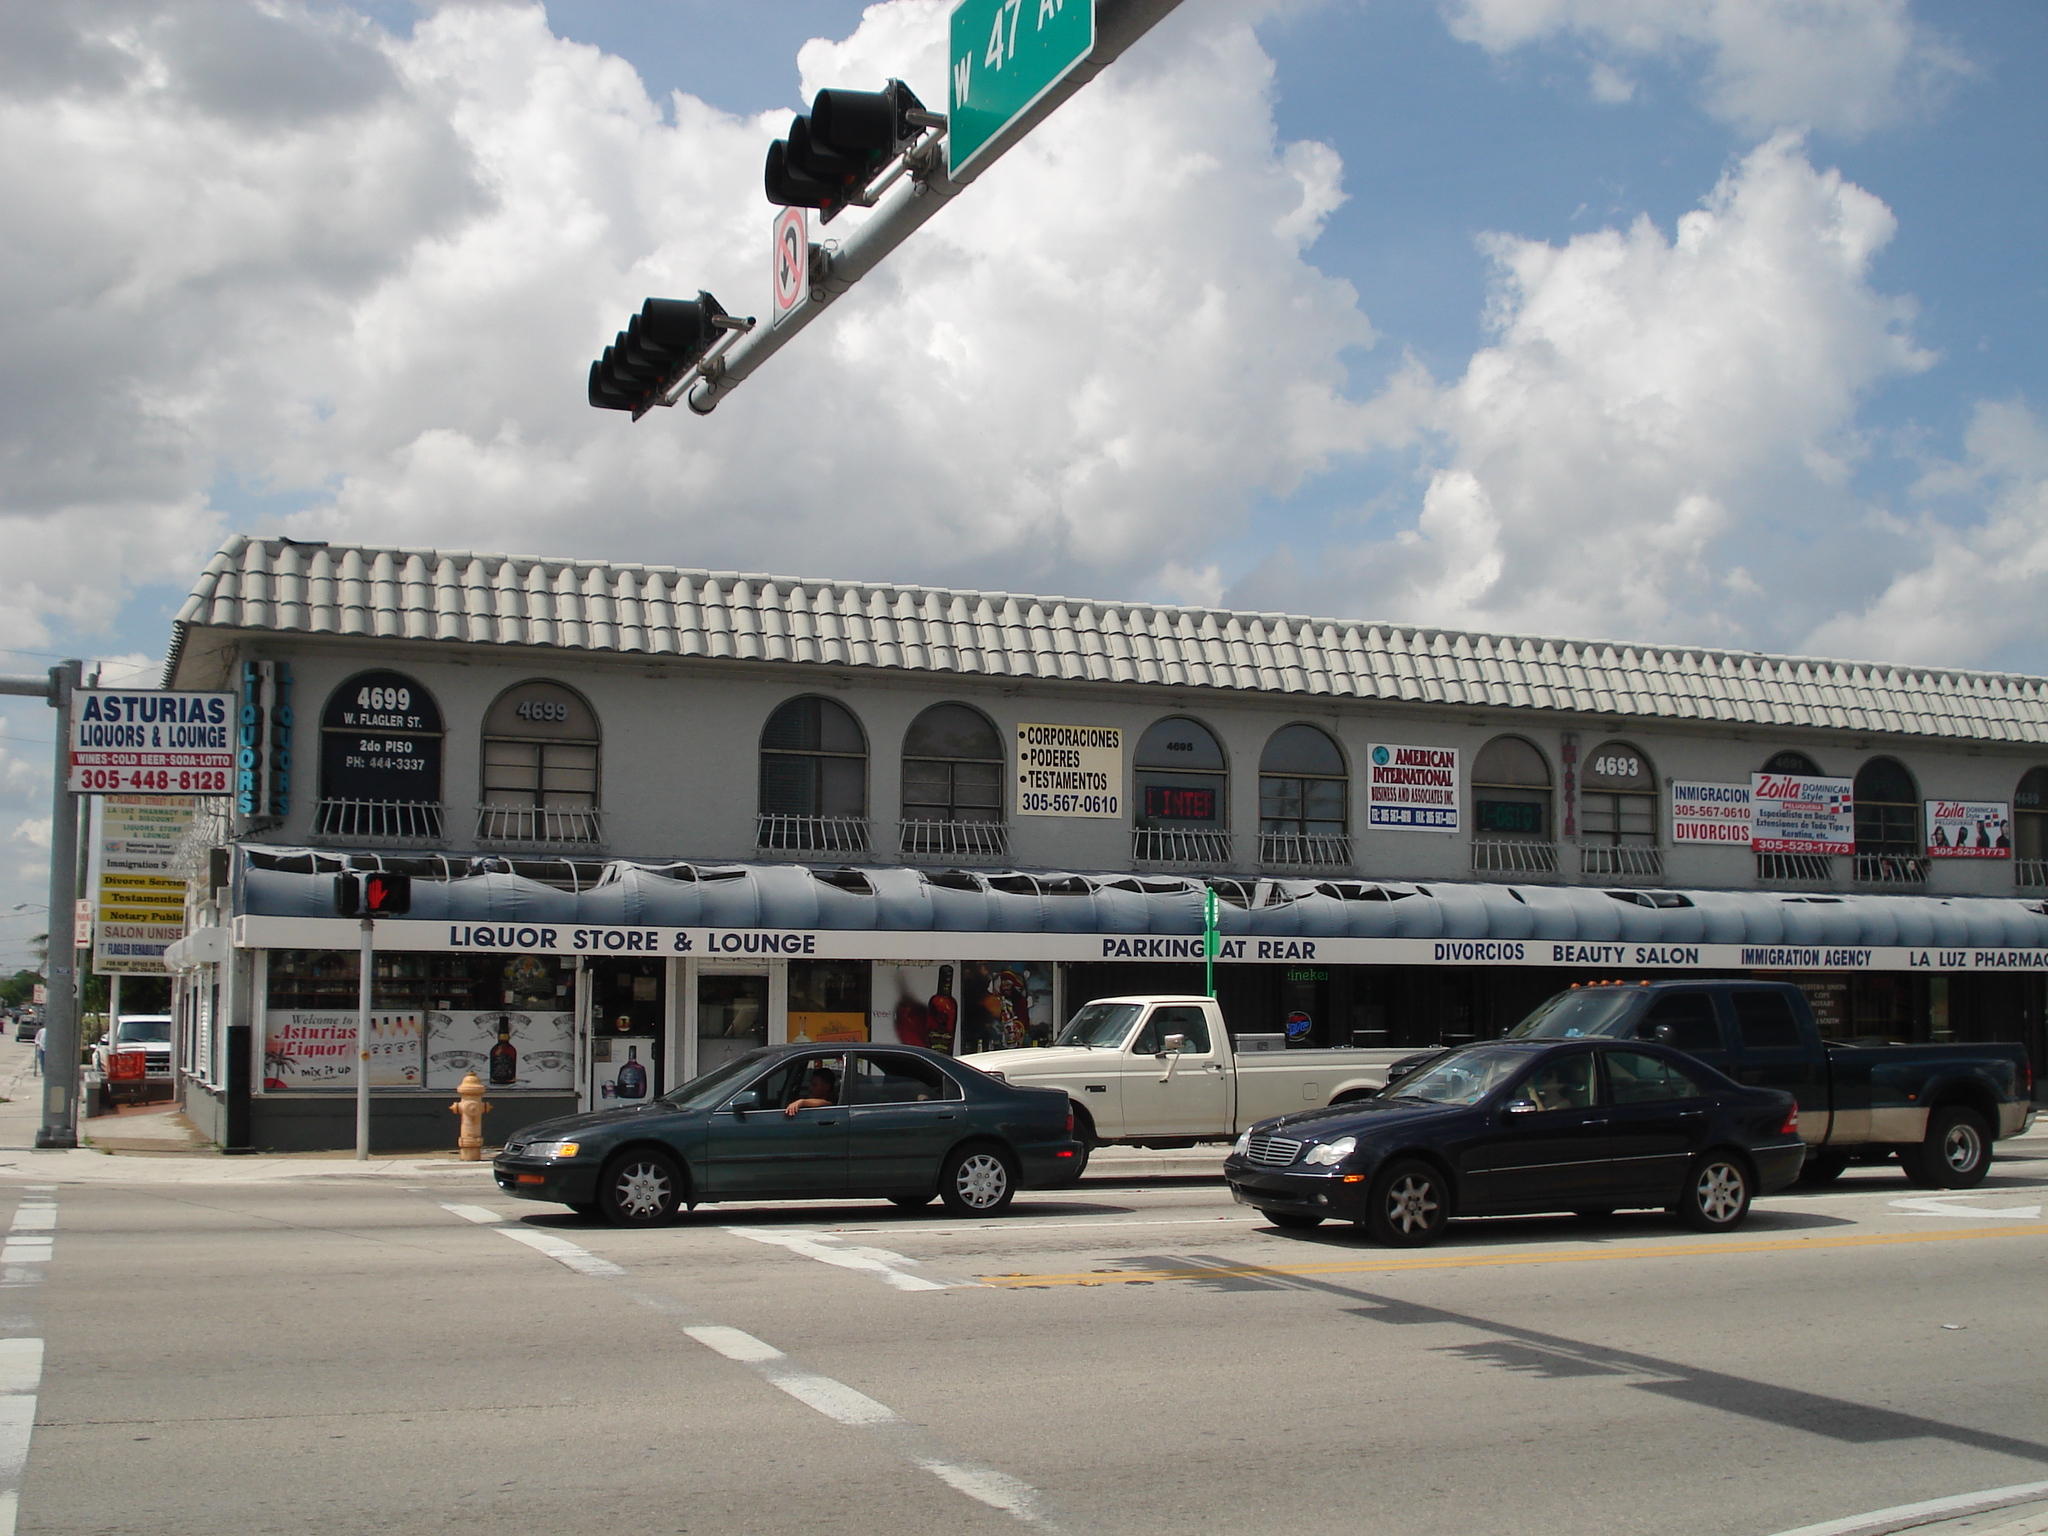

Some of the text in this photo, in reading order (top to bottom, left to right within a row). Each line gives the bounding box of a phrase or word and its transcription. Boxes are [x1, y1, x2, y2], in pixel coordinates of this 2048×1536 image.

[954, 50, 972, 111] W
[985, 0, 1021, 71] 47
[357, 686, 410, 710] 4699
[82, 695, 225, 724] ASTURIAS
[517, 701, 568, 722] 4699
[344, 712, 422, 728] W. FLAGLER ST.
[80, 725, 226, 748] LIQUORS & LOUNGE
[238, 662, 256, 814] LIQUORS
[279, 662, 294, 815] LIQUORS
[1028, 726, 1119, 748] CORPORACIONES
[360, 739, 412, 753] 2do PISO
[77, 753, 230, 766] WINES-COLD BEER-SODA-LOTTO
[346, 756, 425, 770] PH: 444-3337
[1030, 748, 1080, 768] PODERES
[1395, 748, 1455, 768] AMERICAN
[1595, 757, 1638, 777] 4693
[81, 769, 225, 790] 305-448-8128
[1028, 770, 1107, 790] TESTAMENTOS
[1373, 766, 1453, 787] INTERNATIONAL
[1675, 786, 1749, 803] INMIGRACION
[1756, 775, 1850, 799] Zoila DOMINICAN
[1022, 793, 1117, 813] 305-567-0610
[1371, 786, 1397, 802] BUSINESS
[1398, 787, 1410, 802] AND
[1411, 788, 1443, 805] ASSOCIATES
[1801, 792, 1823, 802] Style
[139, 808, 178, 816] PHARMACY
[1675, 805, 1751, 818] 305-567-0610
[1784, 802, 1822, 810] PELUQUERIA
[1935, 802, 1965, 818] Zoila
[1760, 809, 1802, 820] Especialista
[159, 825, 182, 833] STORE
[1676, 823, 1749, 841] DIVORCIOS
[1756, 818, 1798, 828] Extensiones
[1801, 820, 1809, 829] de
[1811, 820, 1827, 830] Todo
[1829, 822, 1843, 833] Tipo
[1816, 832, 1828, 840] etc.
[1758, 840, 1849, 853] 305-529-1773
[1934, 847, 2006, 856] 305-529-1773
[107, 859, 159, 869] Immigration
[105, 876, 186, 887] Divorce Servic
[111, 893, 185, 903] Testamentos
[110, 912, 149, 922] Notary
[105, 926, 183, 939] SALON UNISE
[450, 926, 815, 954] LIQUOR STORE & LOUNGE
[108, 944, 130, 955] FLAGLER
[1102, 938, 1316, 959] PARKING AT REAR
[1434, 943, 1525, 961] DIVORCIOS
[1552, 945, 1627, 963] BEAUTY
[1635, 947, 1699, 964] SALON
[1741, 948, 1819, 967] IMMIGRATION
[1824, 949, 1872, 967] AGENCY
[1910, 951, 1931, 967] LA
[1939, 952, 1966, 967] LUZ
[292, 1014, 353, 1025] Welcome to
[274, 1025, 357, 1039] Asturias
[285, 1042, 347, 1058] Liquor
[301, 1067, 321, 1077] mix
[325, 1065, 335, 1075] it
